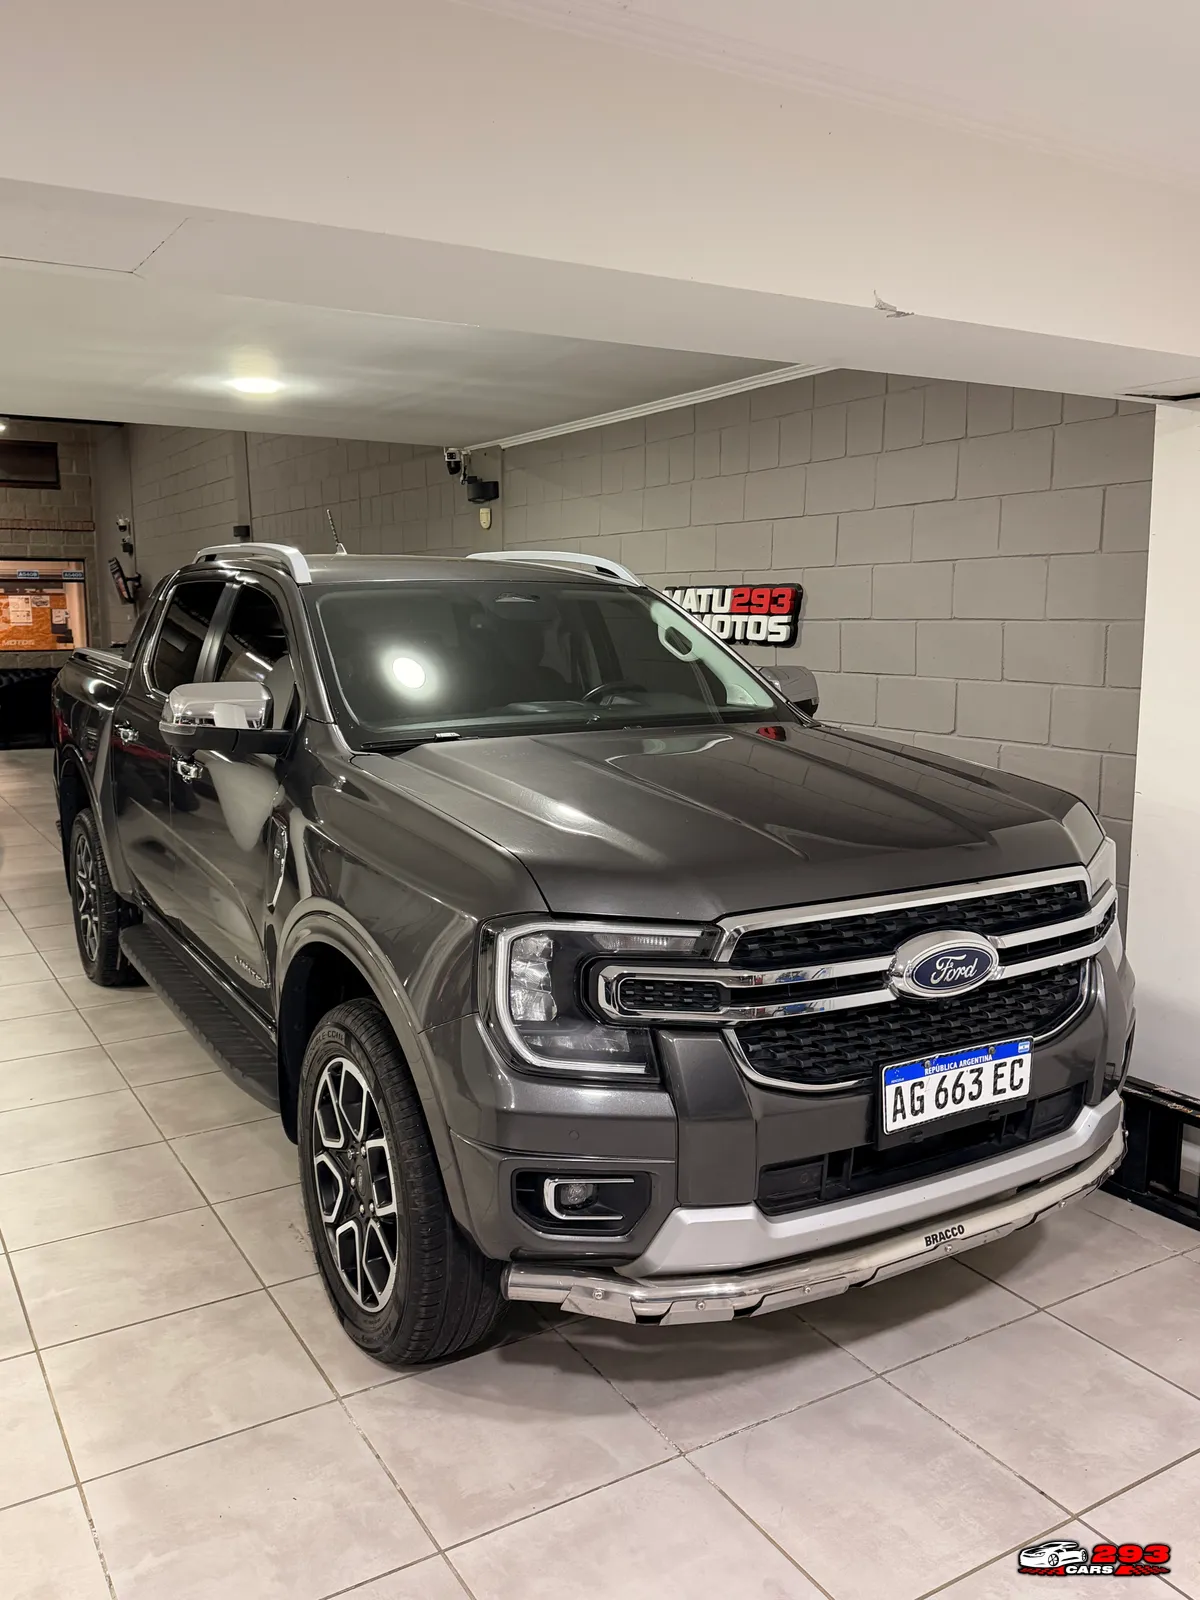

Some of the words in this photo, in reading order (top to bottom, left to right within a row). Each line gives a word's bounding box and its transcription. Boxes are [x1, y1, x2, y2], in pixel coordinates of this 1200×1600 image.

[930, 954, 979, 984] Ford
[924, 1061, 958, 1076] REPÚBLICA
[959, 1054, 993, 1068] ARGENTINA
[892, 1080, 925, 1123] AG
[934, 1067, 984, 1110] 663
[992, 1058, 1024, 1096] EC
[924, 1224, 965, 1247] BRACCO
